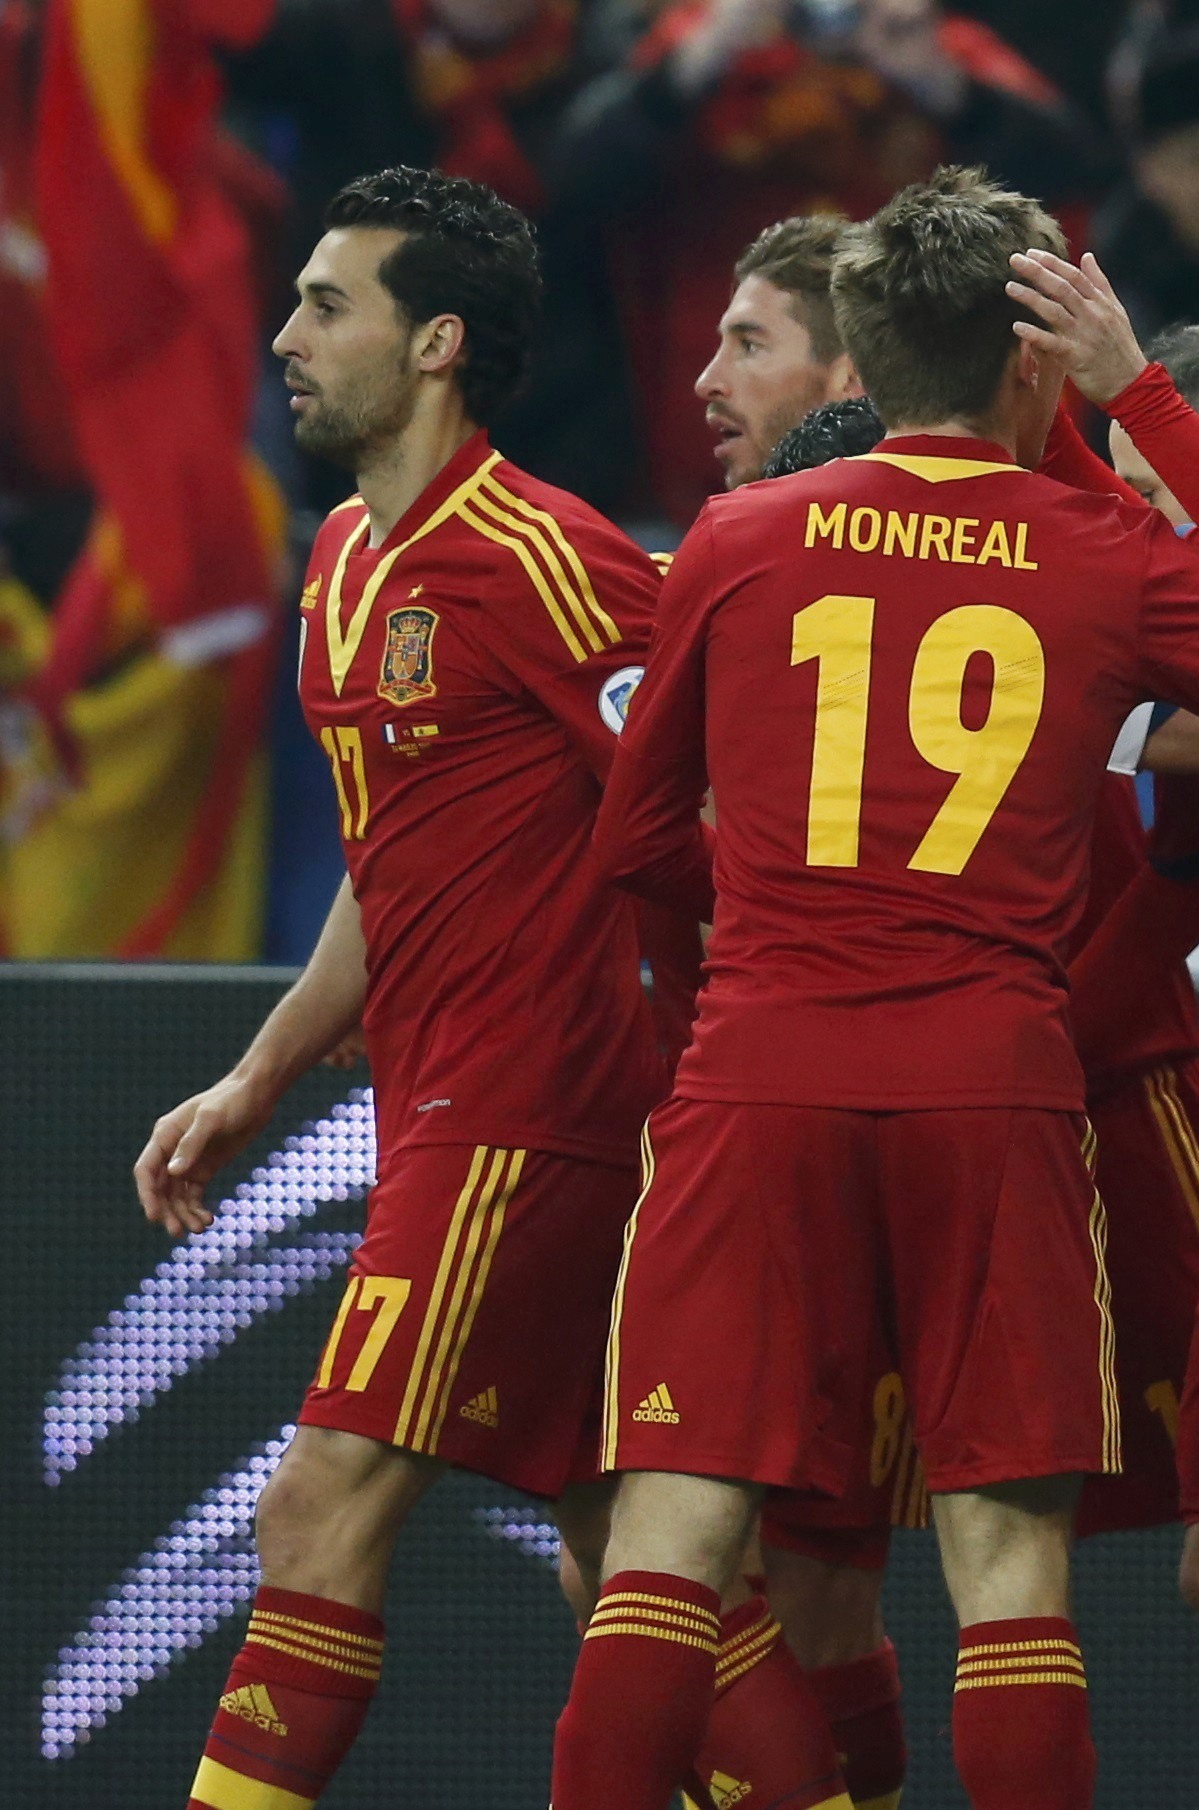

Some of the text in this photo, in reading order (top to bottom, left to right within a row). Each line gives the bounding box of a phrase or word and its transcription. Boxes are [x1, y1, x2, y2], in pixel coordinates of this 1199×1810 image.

[804, 502, 1039, 571] MONREAL
[790, 594, 1046, 877] 19
[320, 726, 368, 840] 17
[316, 1275, 412, 1392] 17
[632, 1407, 680, 1424] adidas
[220, 1695, 288, 1736] adidas
